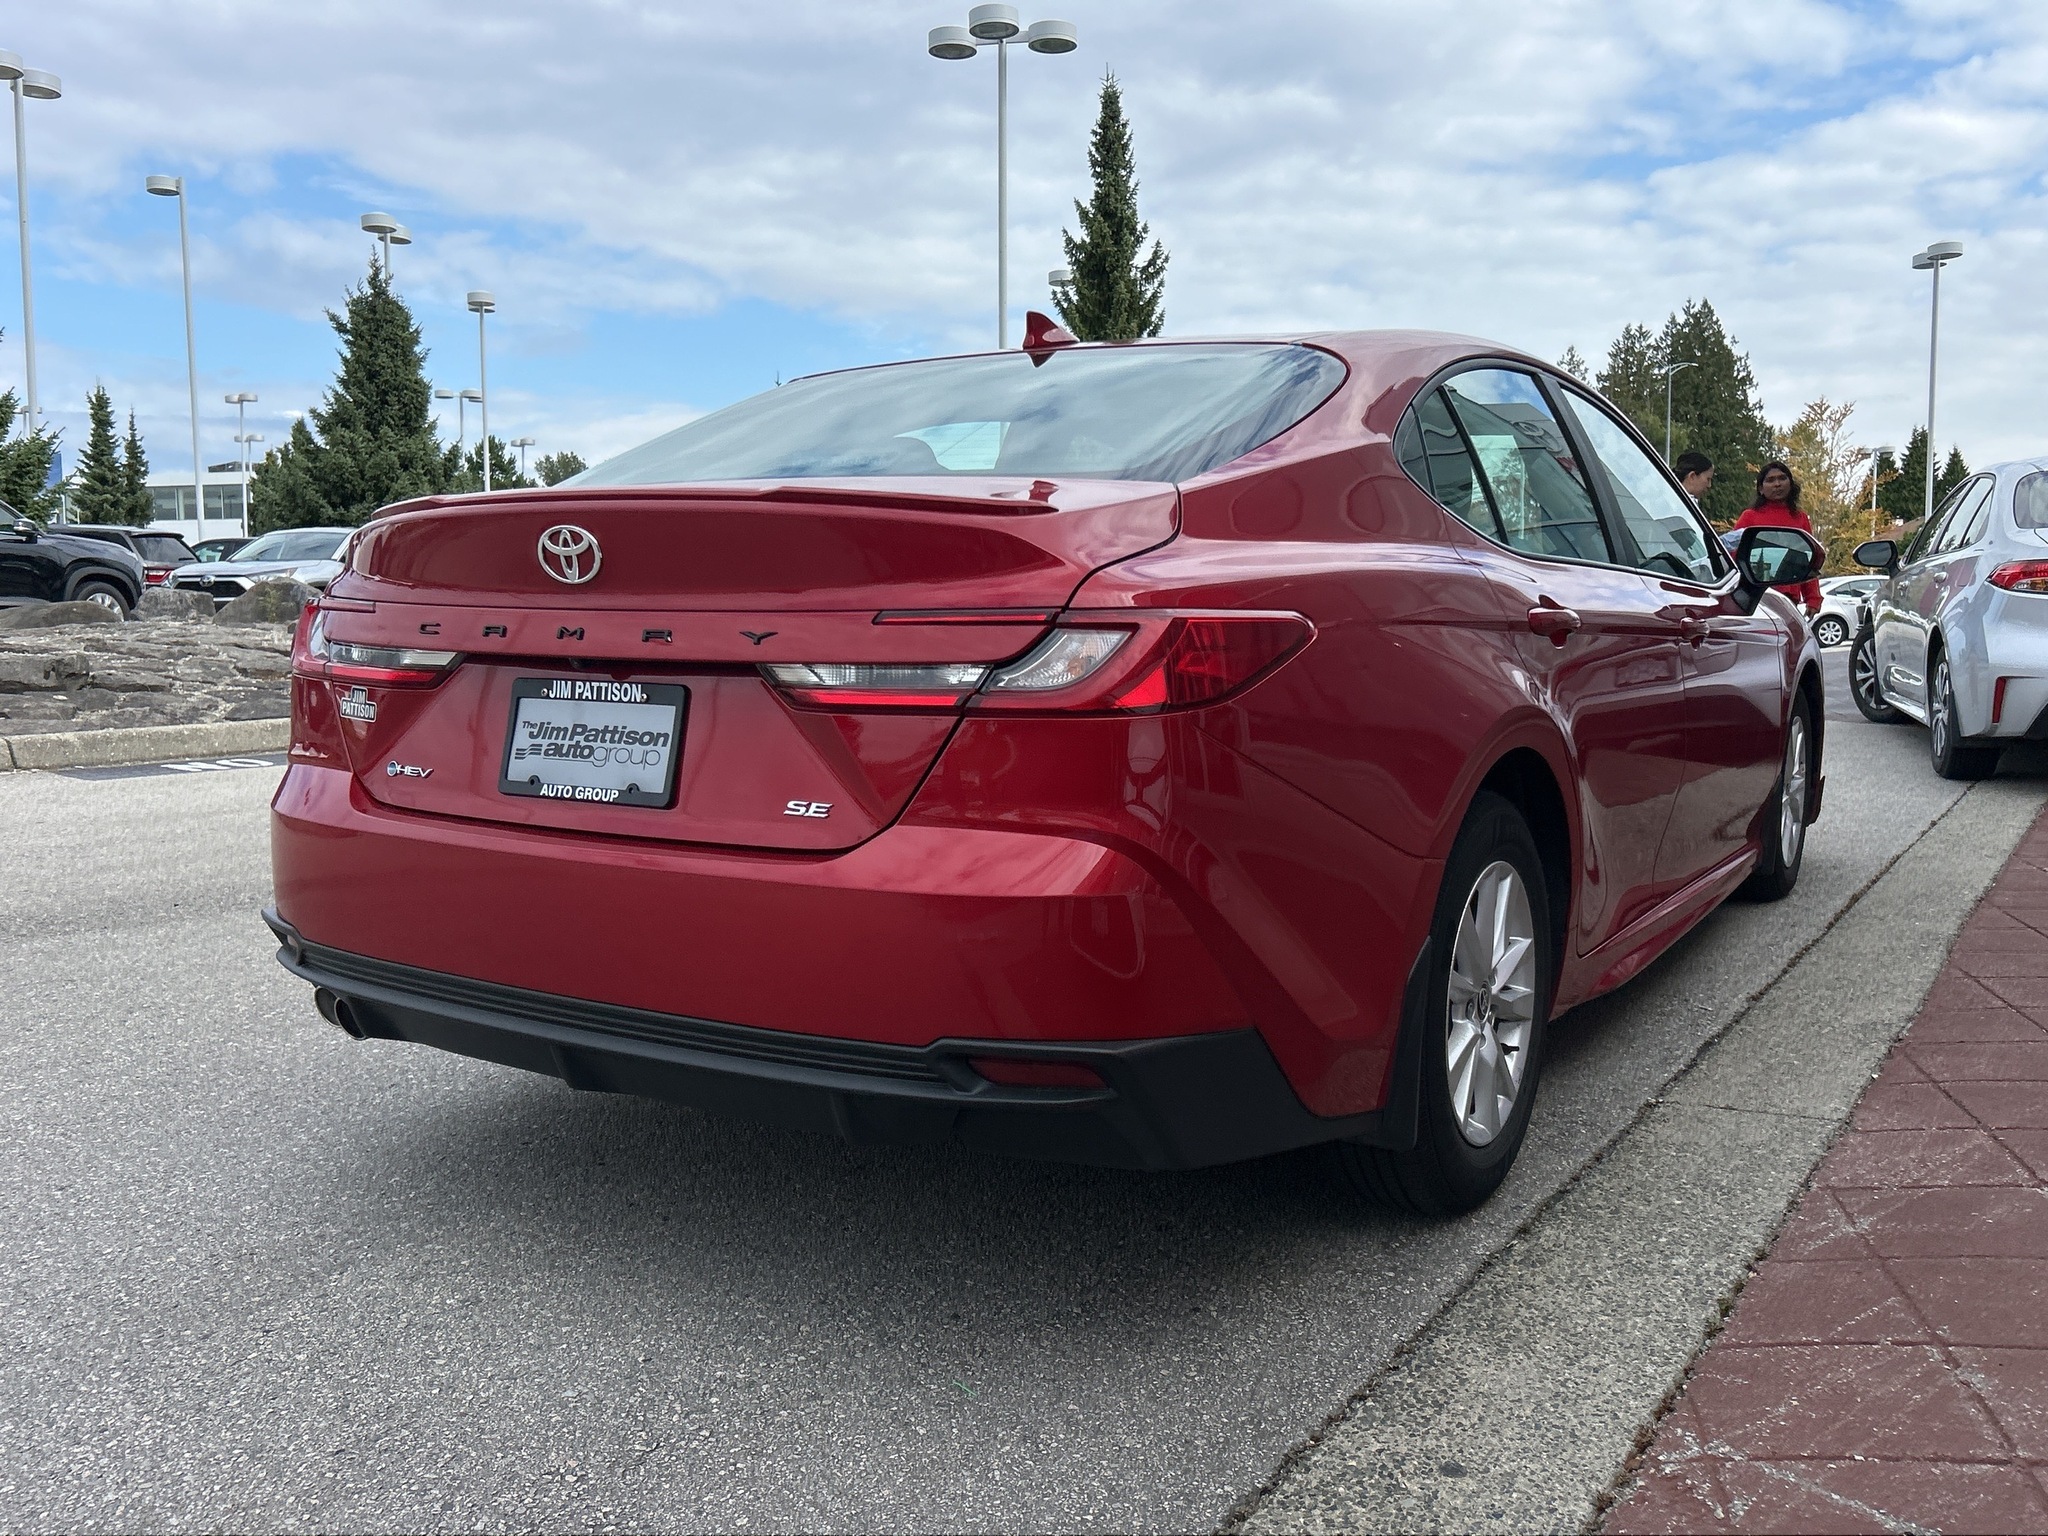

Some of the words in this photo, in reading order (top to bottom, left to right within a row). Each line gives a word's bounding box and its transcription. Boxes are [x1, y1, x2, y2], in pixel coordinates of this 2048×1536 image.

[419, 622, 779, 645] CAMRY
[352, 690, 366, 703] JIM
[549, 680, 572, 699] JIM
[575, 682, 642, 702] PATTISON
[342, 702, 375, 719] PATTISON
[522, 720, 538, 730] The
[397, 764, 434, 777] HEV
[540, 783, 573, 798] AUTO
[575, 786, 619, 802] GROUP
[783, 800, 833, 818] SE
